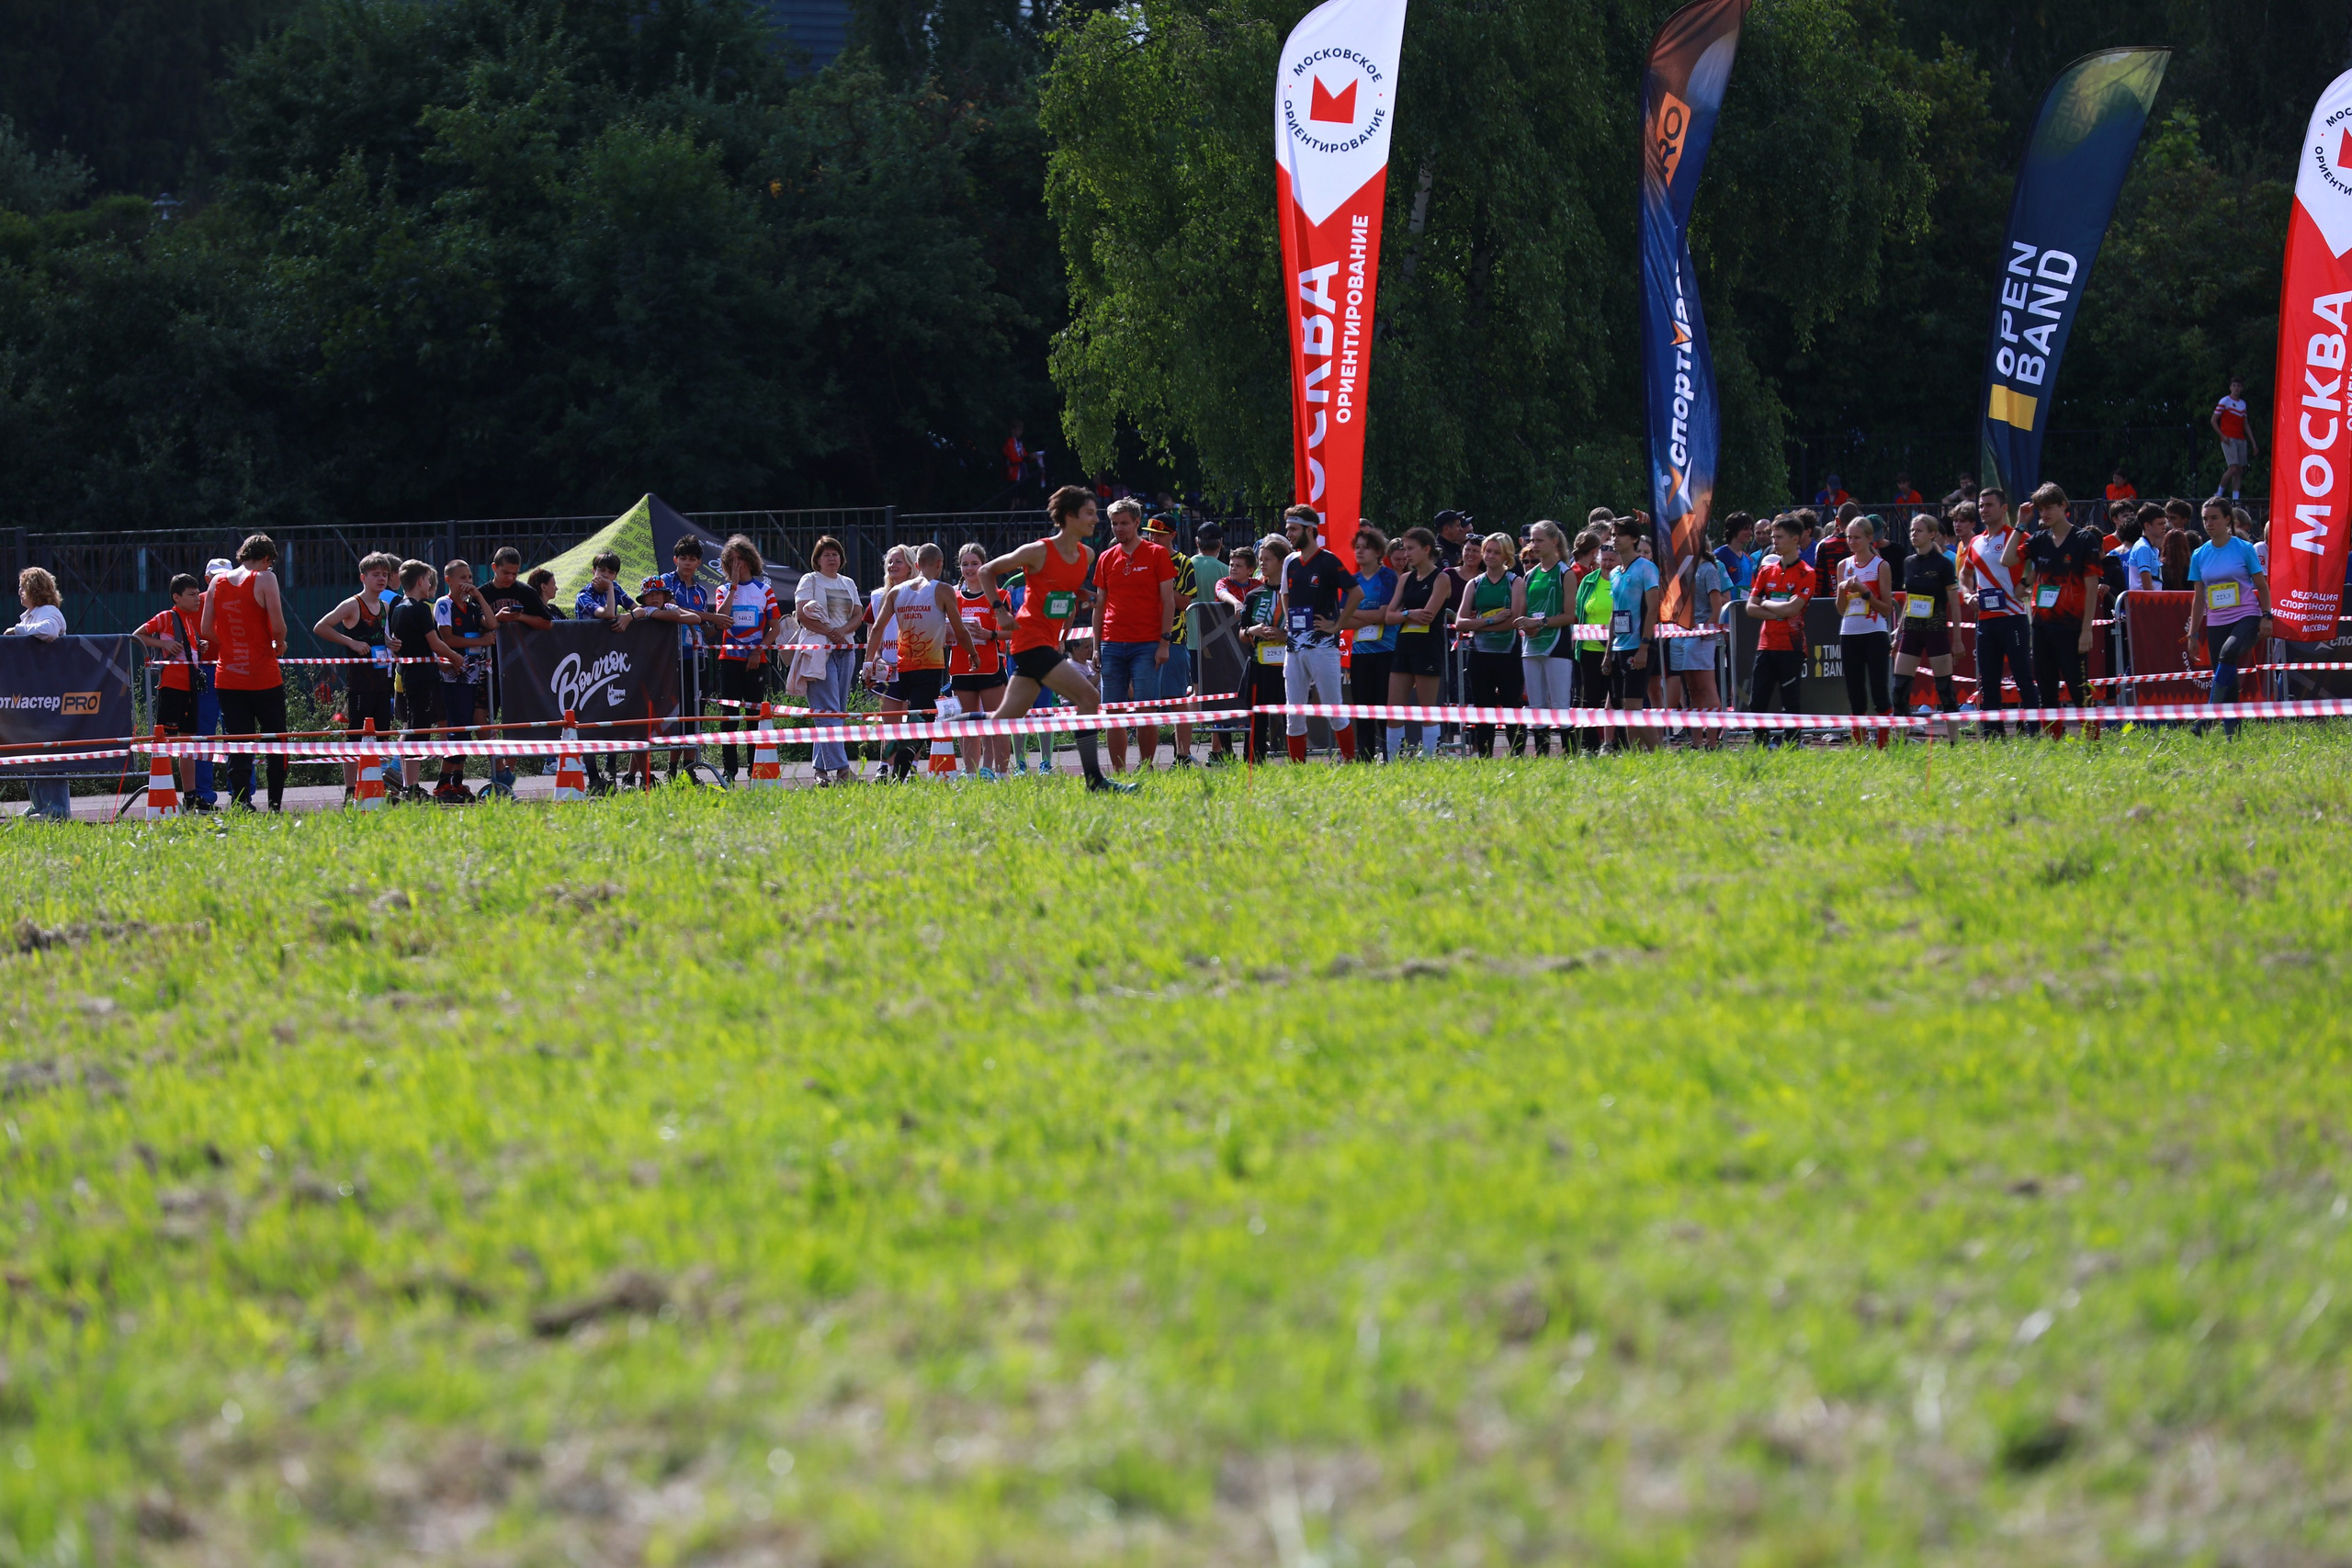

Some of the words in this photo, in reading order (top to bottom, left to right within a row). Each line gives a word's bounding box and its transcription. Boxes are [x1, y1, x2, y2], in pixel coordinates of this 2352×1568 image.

[1293, 48, 1383, 83] МОСКОВСКОЕ
[1284, 99, 1385, 152] ОРИЕНТИРОВАНИЕ
[1658, 106, 1683, 175] RO
[1336, 214, 1369, 423] ОРИЕНТИРОВАНИЕ
[1996, 241, 2038, 378] OPEN
[2016, 249, 2078, 386] BAND
[2290, 290, 2352, 556] МОСКВА
[64, 695, 97, 711] PRO
[1823, 661, 1845, 678] BAN
